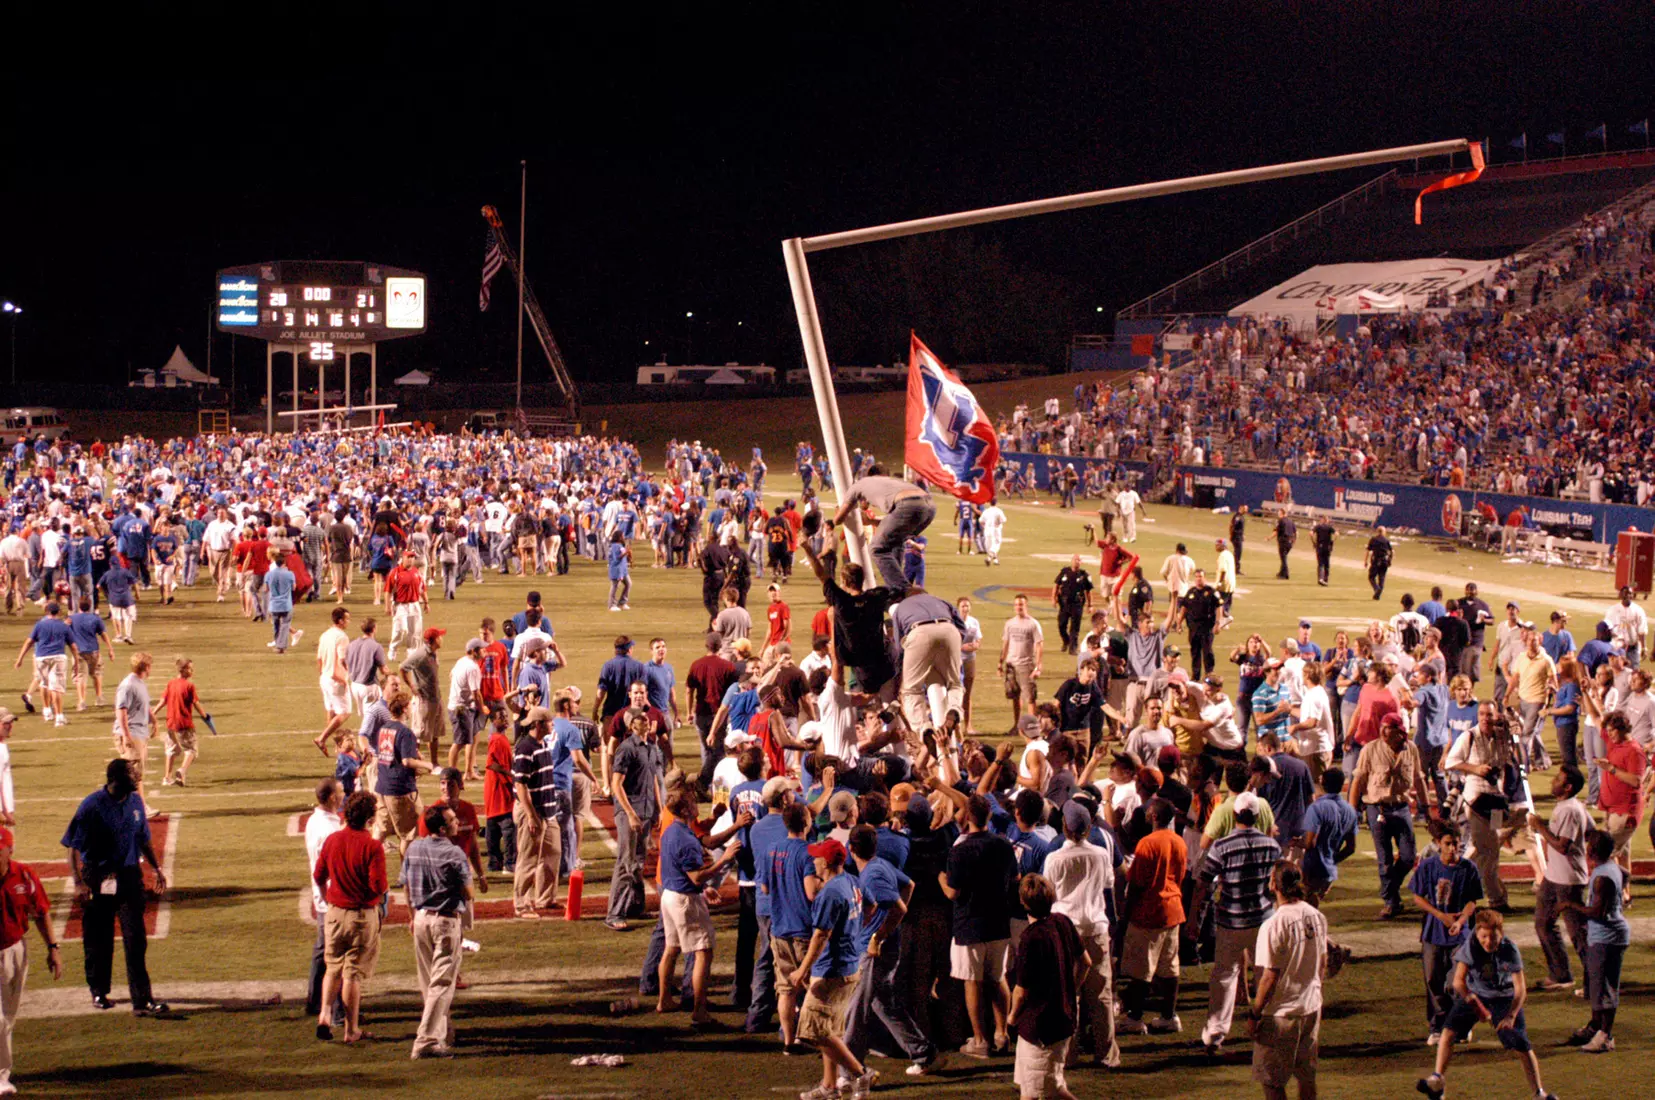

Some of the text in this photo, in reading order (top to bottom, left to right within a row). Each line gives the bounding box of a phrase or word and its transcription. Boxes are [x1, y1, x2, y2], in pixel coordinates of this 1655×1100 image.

[284, 313, 294, 326] 3
[280, 331, 296, 339] JOE
[330, 331, 365, 340] STADIUM
[310, 342, 334, 360] 25
